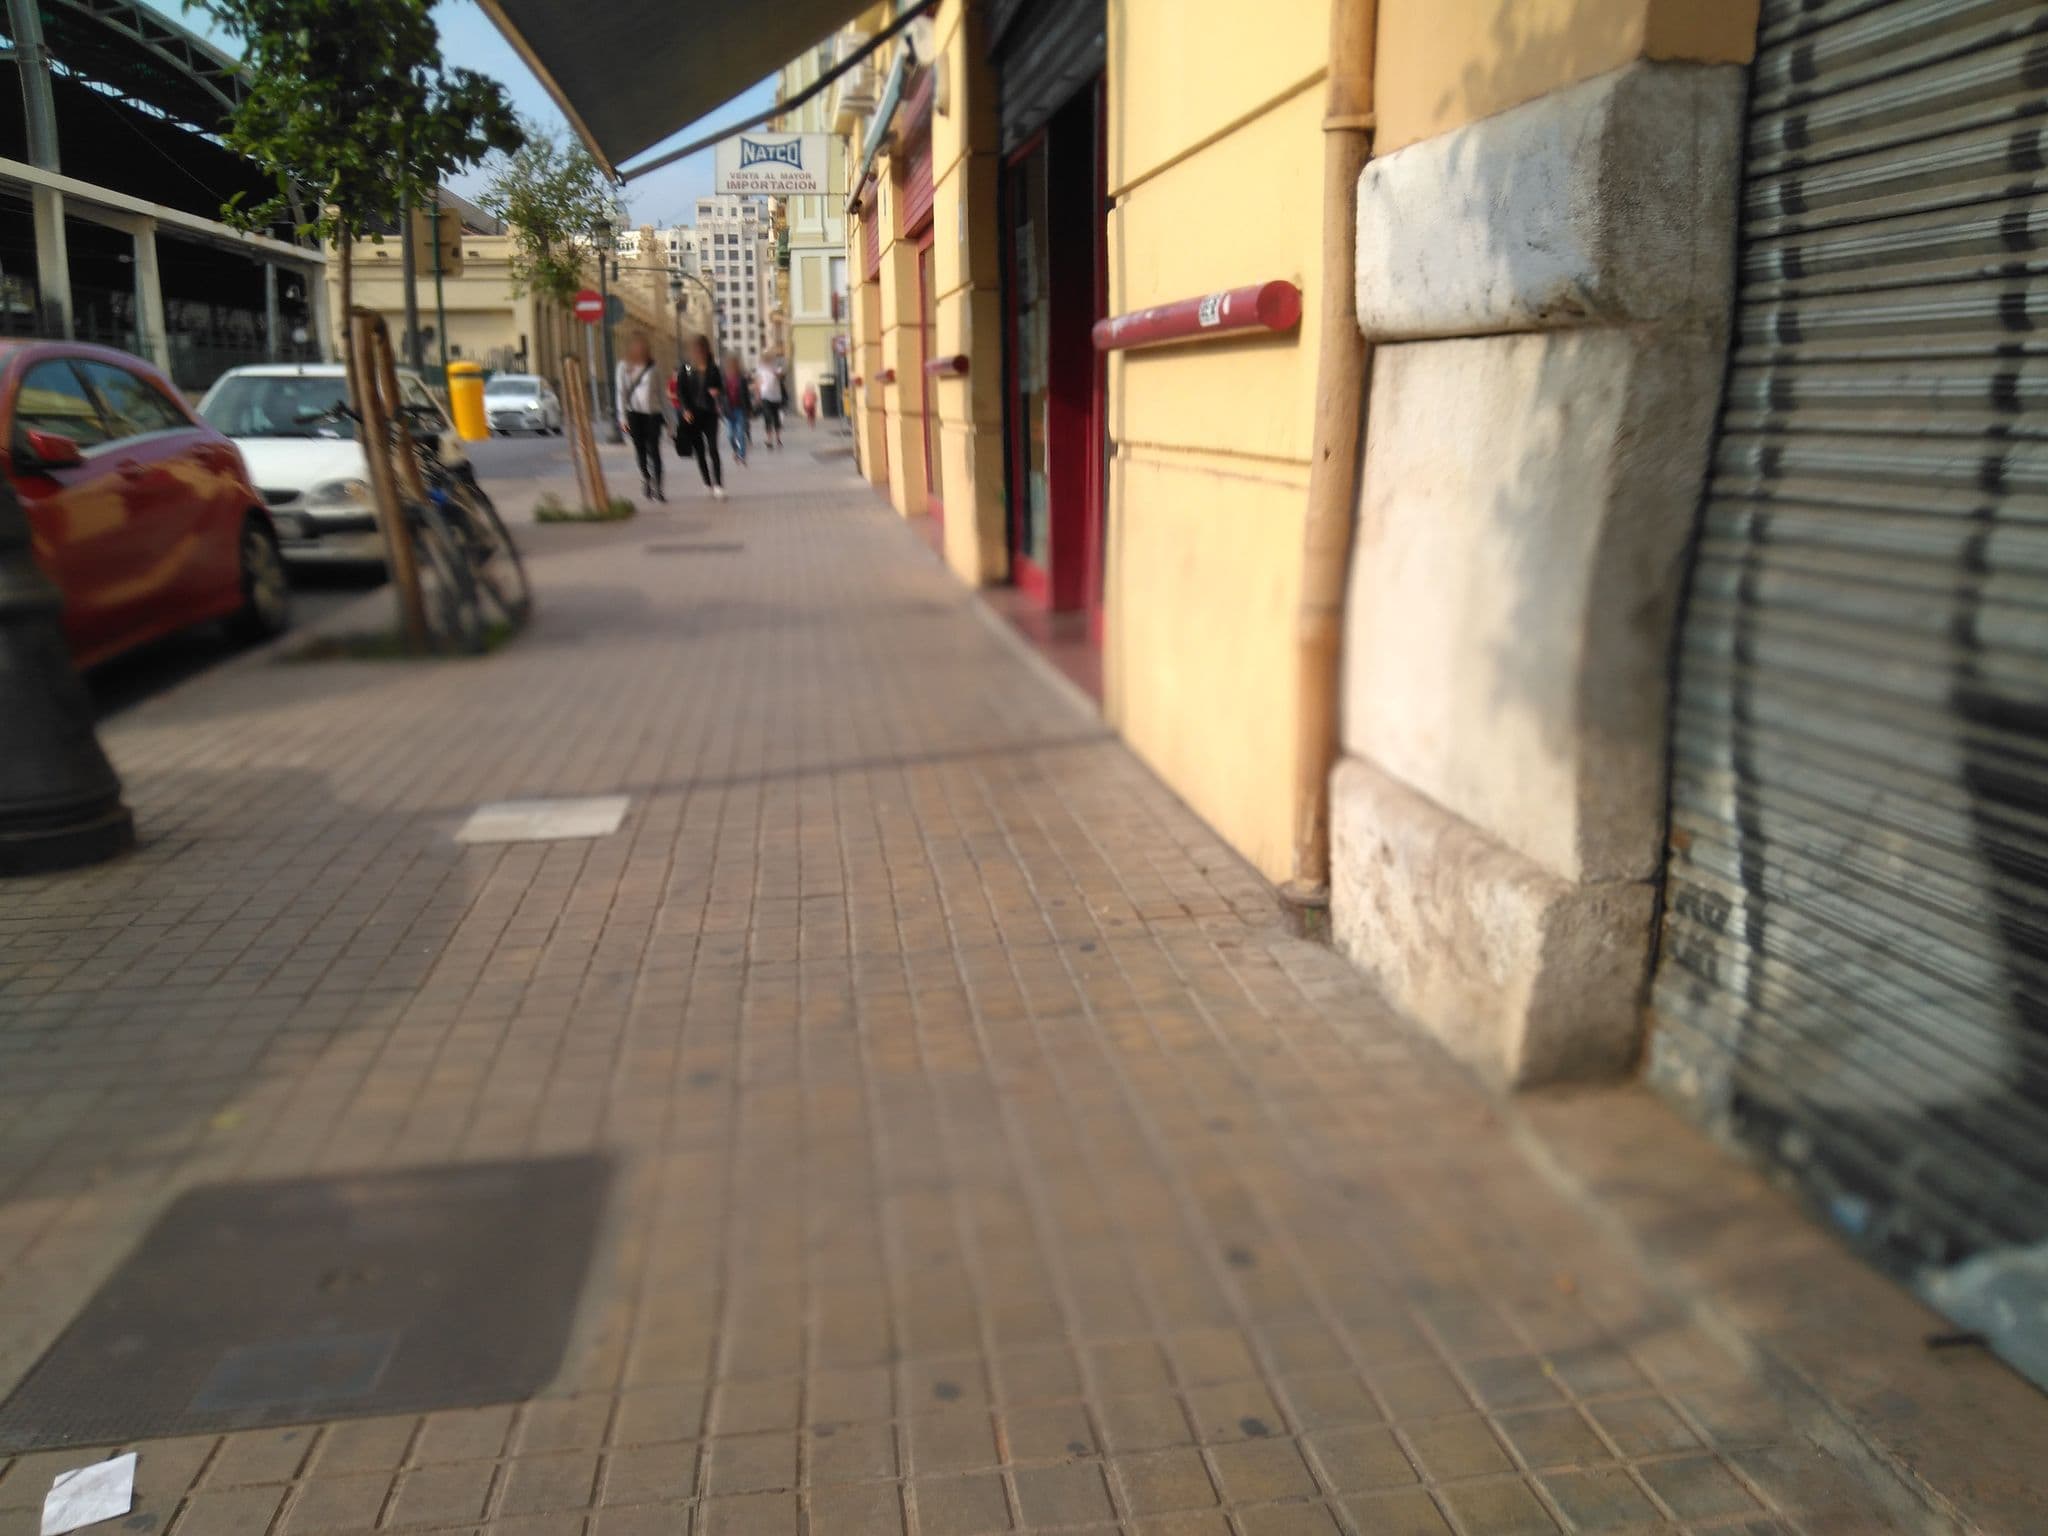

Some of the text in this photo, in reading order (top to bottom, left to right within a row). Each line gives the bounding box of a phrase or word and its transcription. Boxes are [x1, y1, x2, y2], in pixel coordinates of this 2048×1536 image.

[743, 142, 798, 165] NATCO
[729, 172, 811, 180] VENTA AL MAYOR
